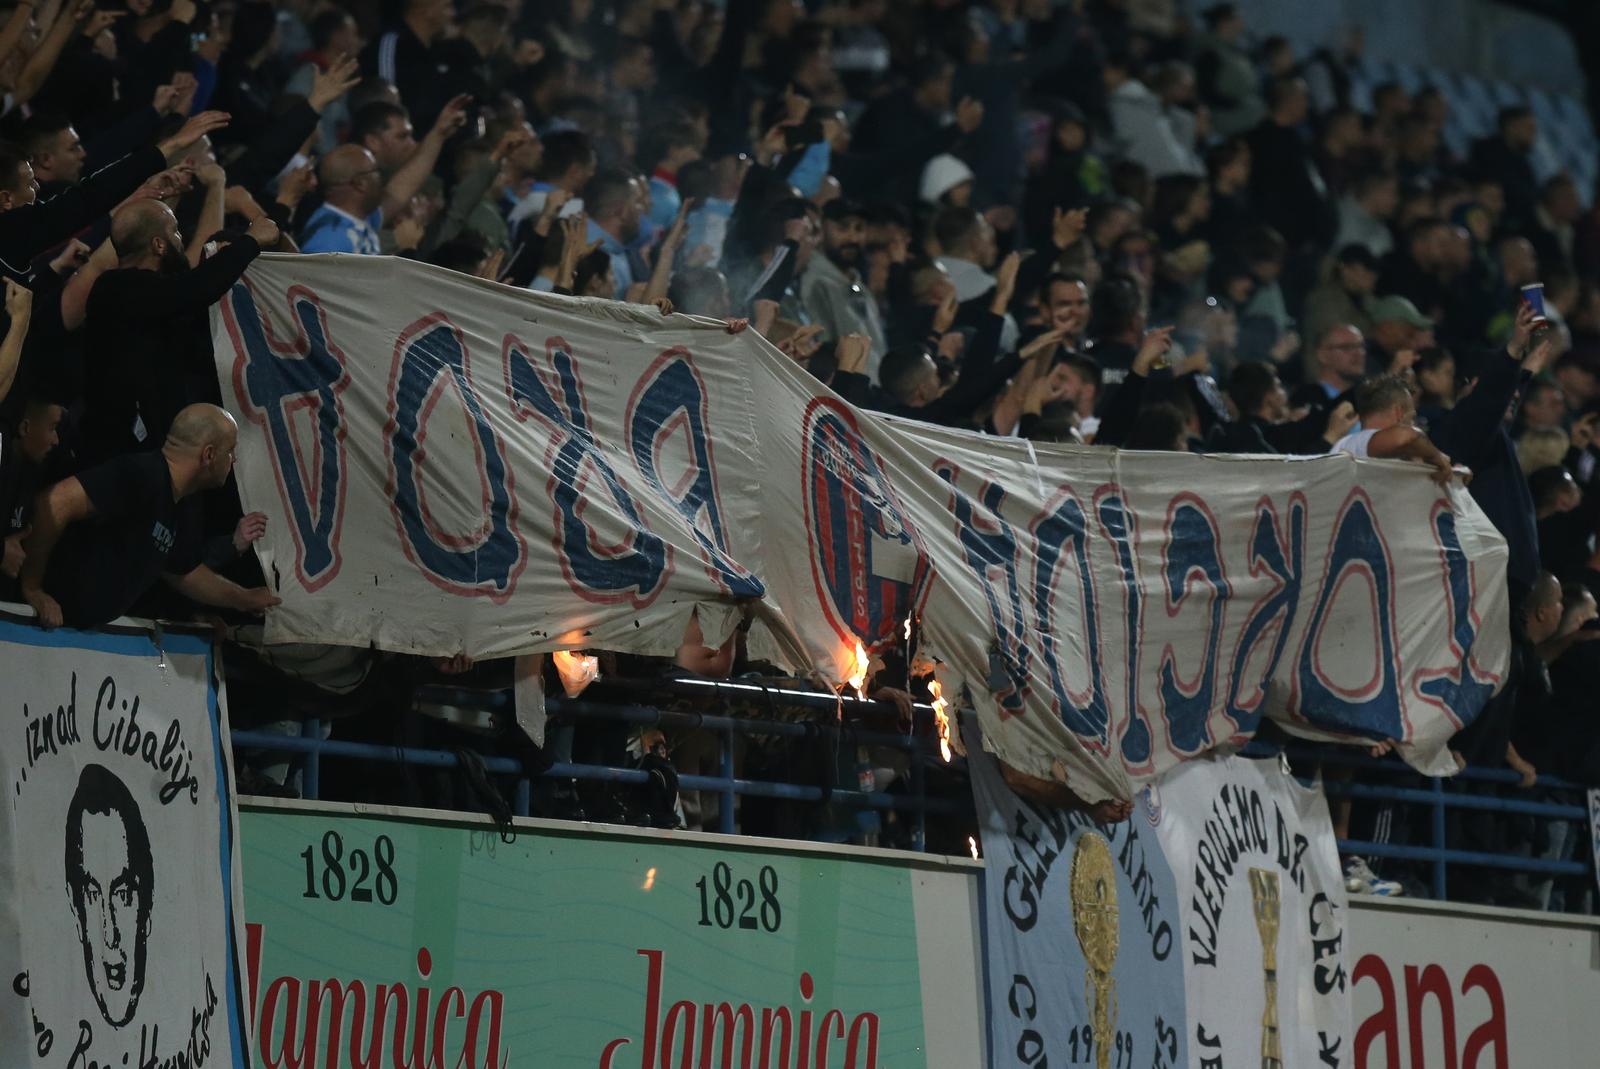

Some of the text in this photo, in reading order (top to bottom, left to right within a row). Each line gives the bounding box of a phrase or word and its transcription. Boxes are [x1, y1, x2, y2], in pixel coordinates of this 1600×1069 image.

[219, 274, 1499, 774] TORCIDA BRDA
[93, 676, 198, 805] Cibalije
[301, 830, 398, 906] 1828
[696, 861, 782, 933] 1828
[1190, 784, 1268, 968] VJERUJEMO
[1273, 800, 1309, 894] DA
[600, 949, 880, 1069] Jamnica
